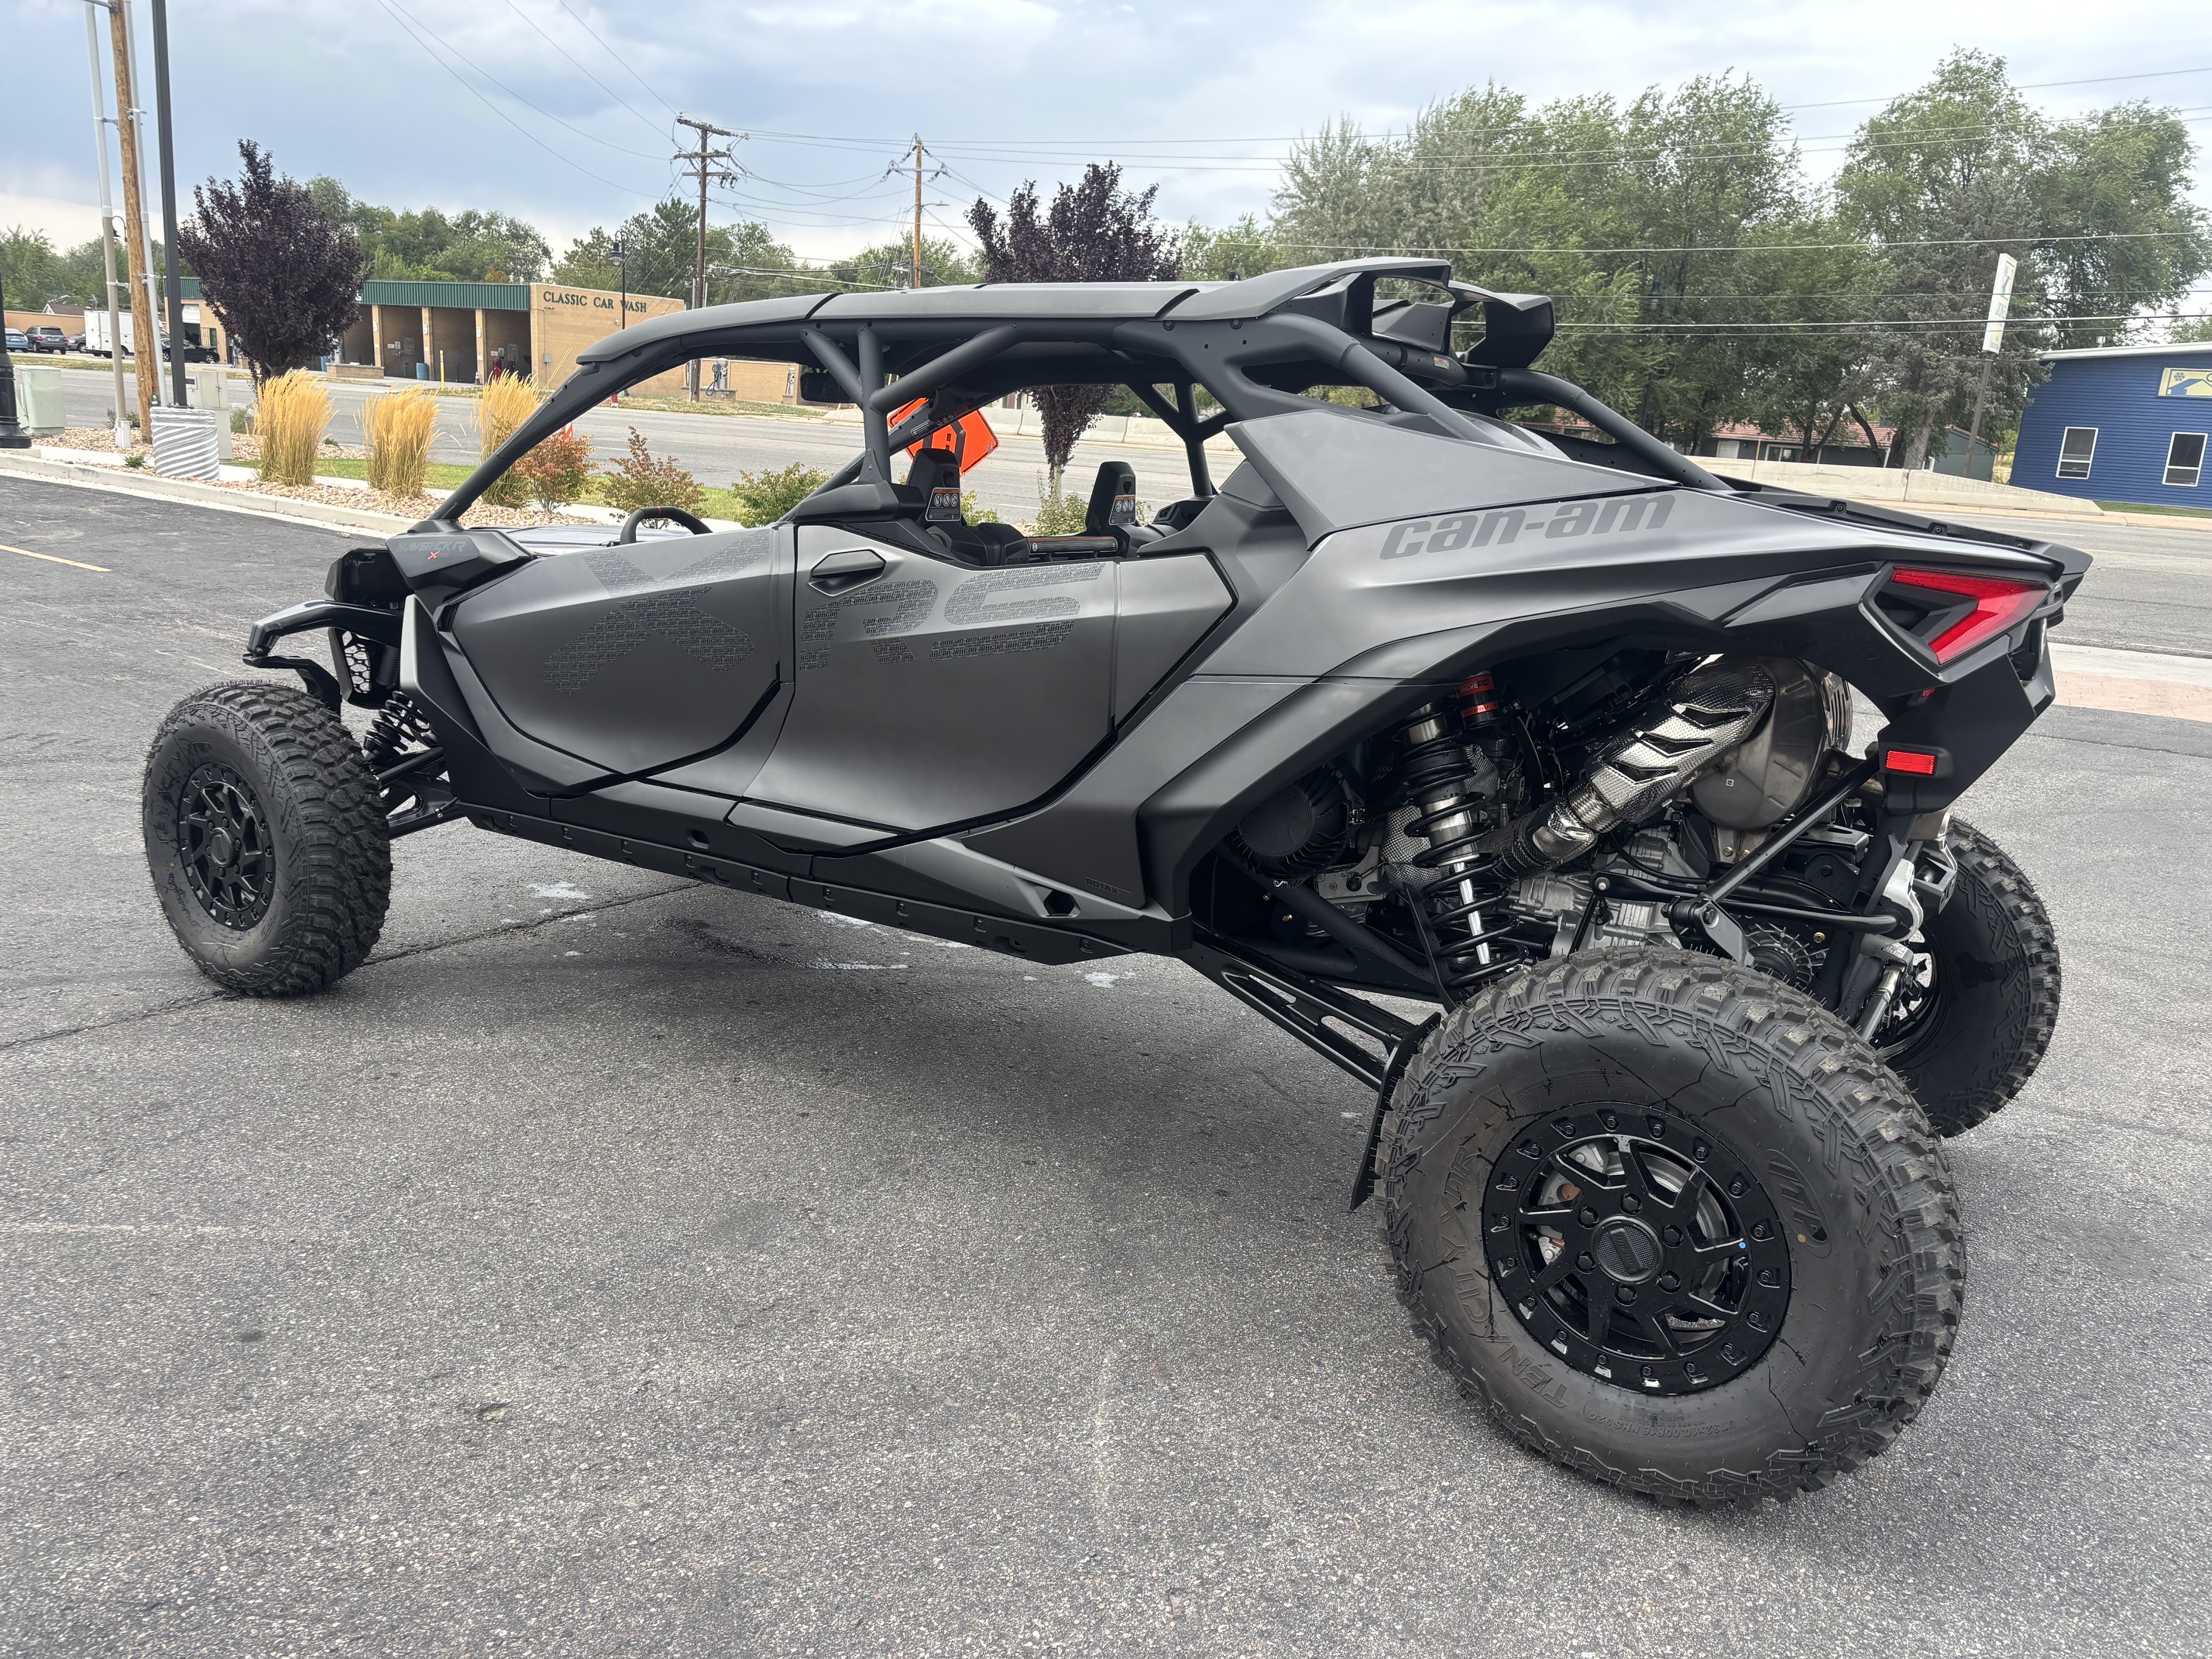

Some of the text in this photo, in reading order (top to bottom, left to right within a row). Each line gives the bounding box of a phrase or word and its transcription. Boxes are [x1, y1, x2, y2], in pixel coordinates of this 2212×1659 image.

[543, 291, 647, 312] CLASSIC CAR WASH
[396, 541, 453, 552] MAVERICK
[1086, 878, 1118, 895] ROTAX
